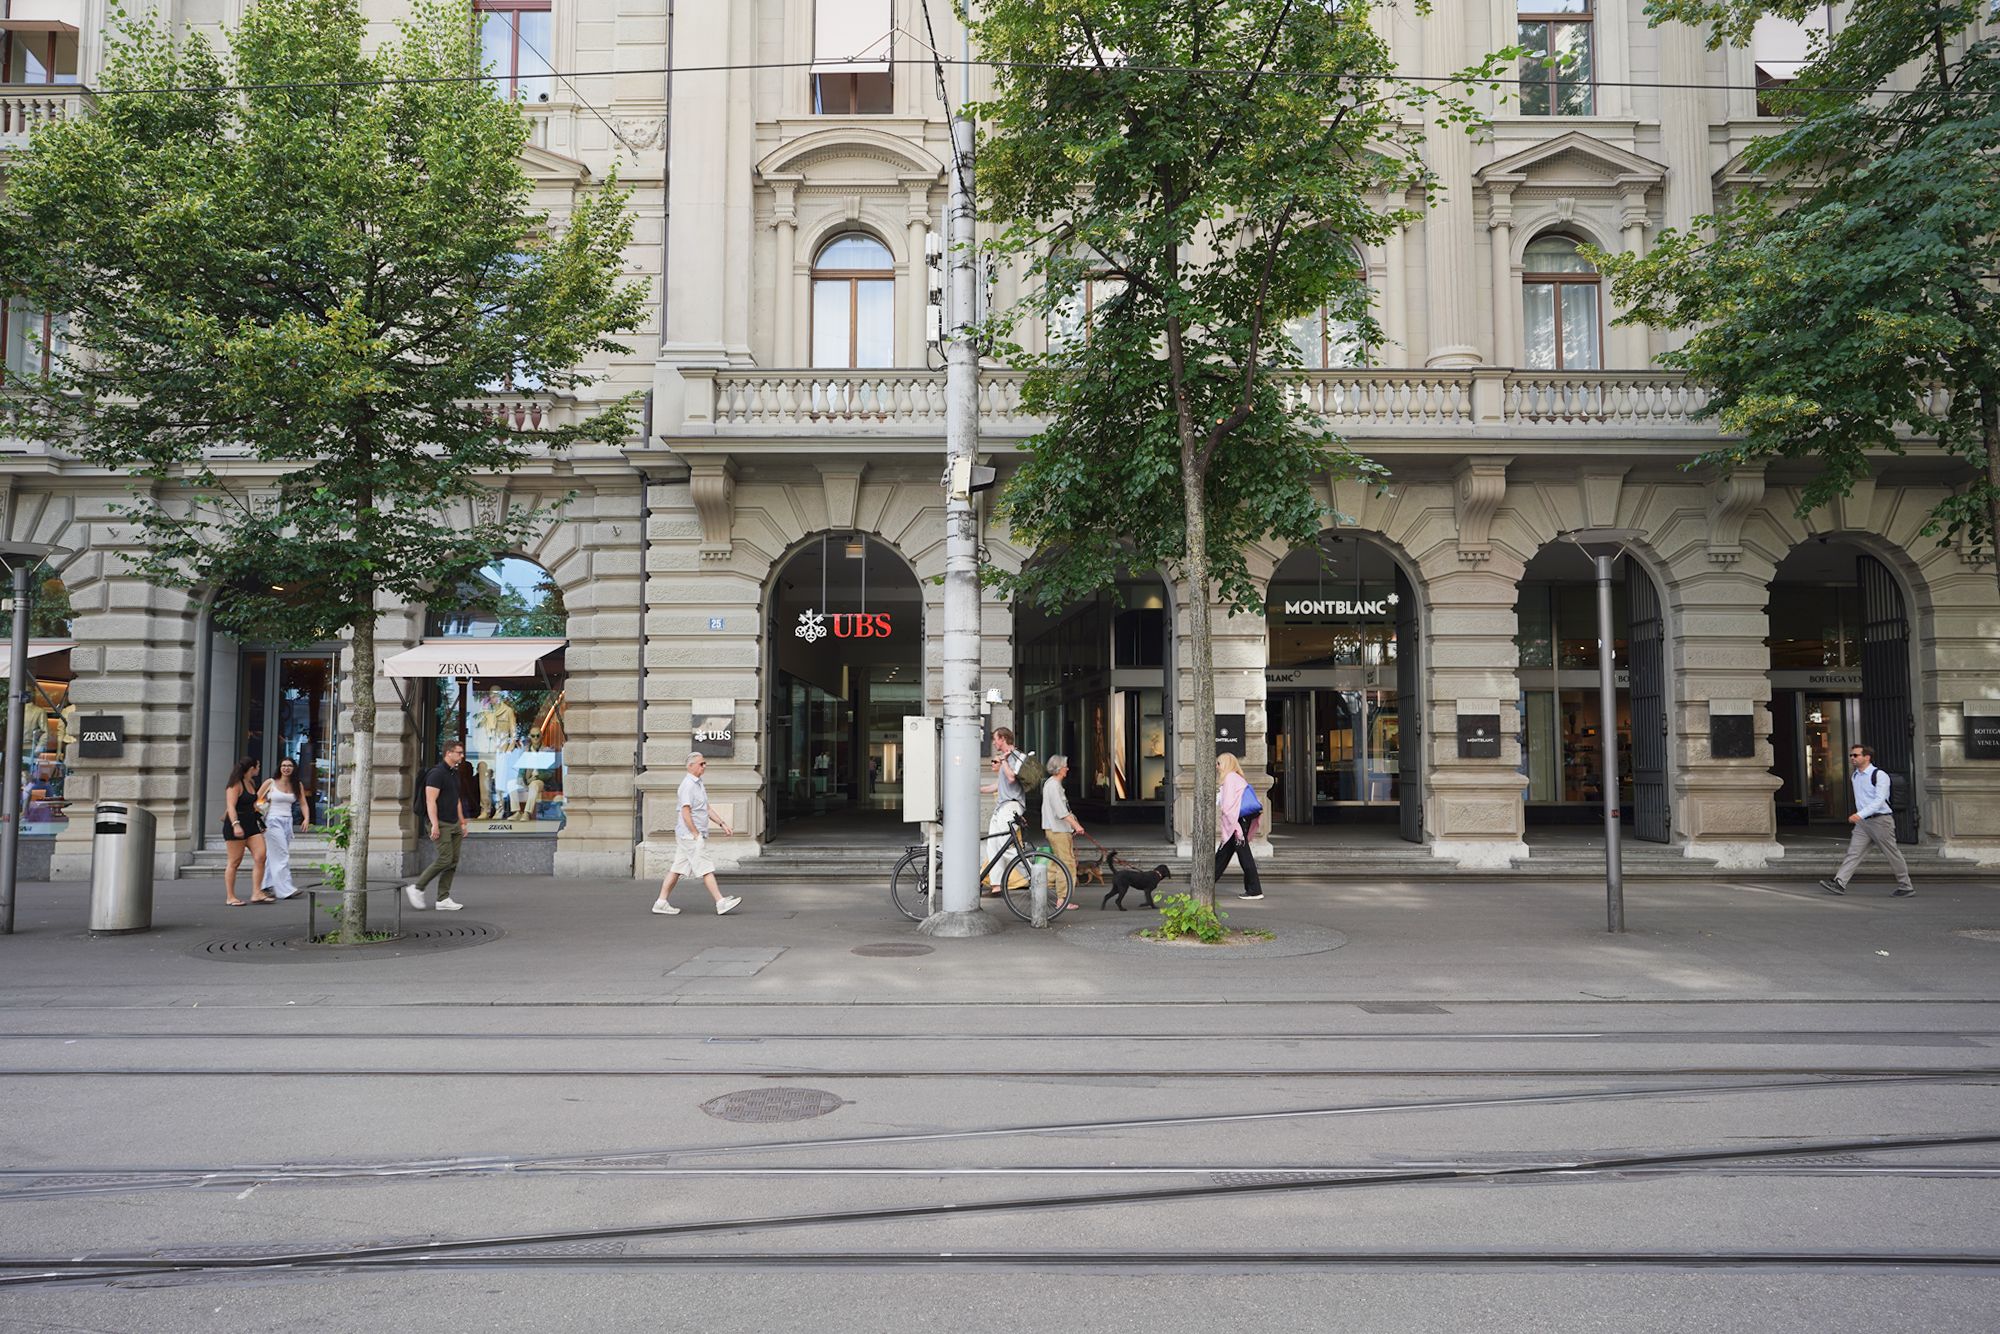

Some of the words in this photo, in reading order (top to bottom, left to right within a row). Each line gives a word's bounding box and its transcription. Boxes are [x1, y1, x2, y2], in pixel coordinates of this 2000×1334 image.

[1285, 600, 1387, 615] MONTBLANC
[711, 619, 722, 629] 25
[831, 613, 892, 638] UBS
[438, 662, 481, 675] ZEGNA
[1809, 675, 1846, 683] BOTTEGA
[83, 731, 117, 742] ZEGNA
[708, 730, 731, 741] UBS
